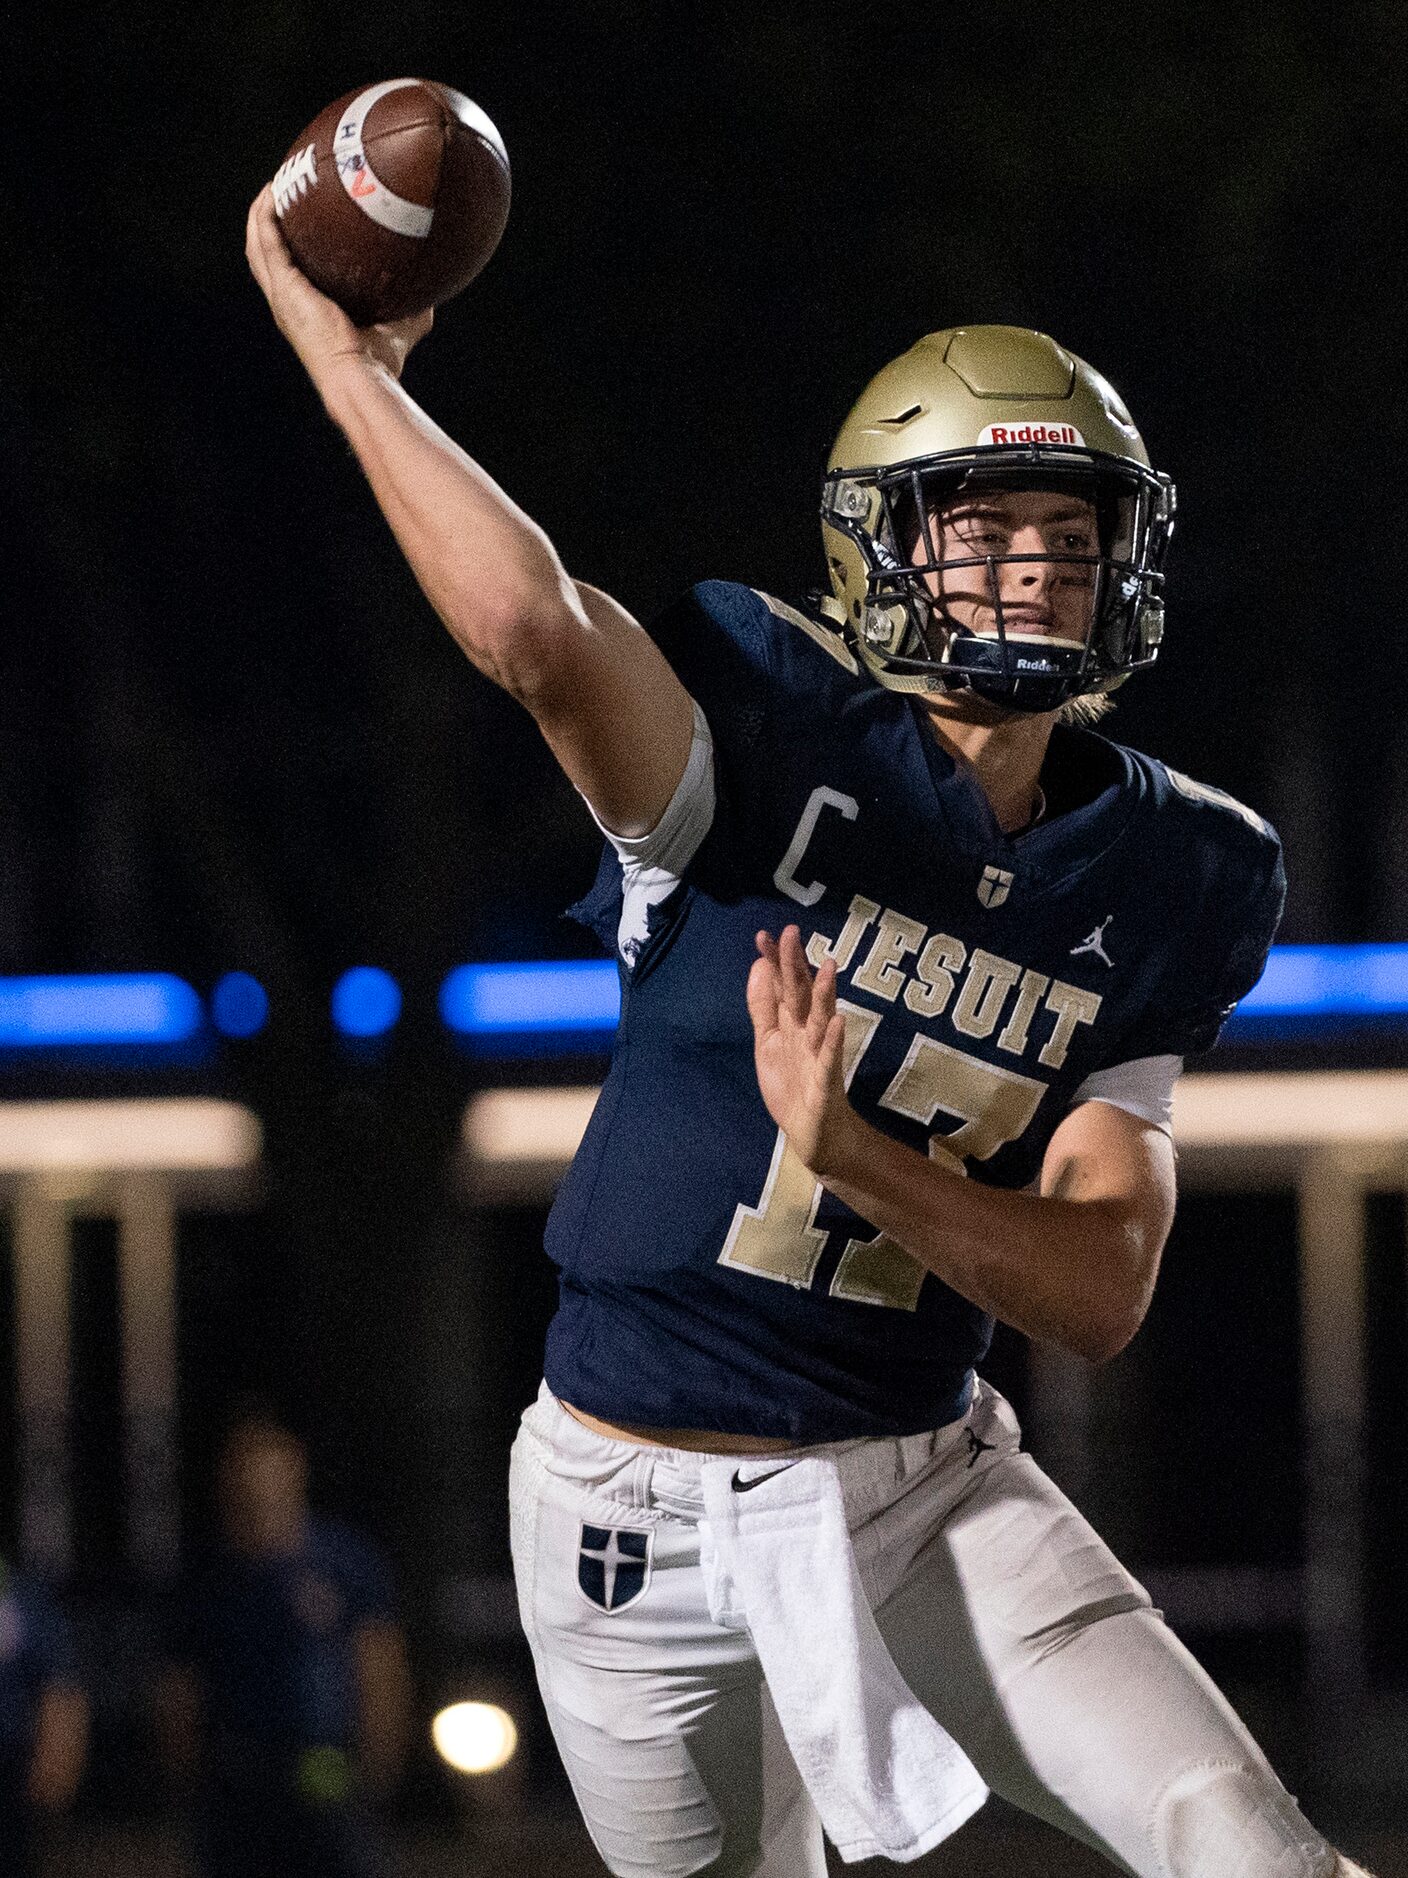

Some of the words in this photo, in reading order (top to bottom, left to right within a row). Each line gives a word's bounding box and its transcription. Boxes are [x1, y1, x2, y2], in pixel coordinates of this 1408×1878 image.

[991, 426, 1075, 444] Riddell
[773, 785, 859, 907] C
[805, 894, 1103, 1070] JESUIT
[717, 998, 1049, 1313] 17
